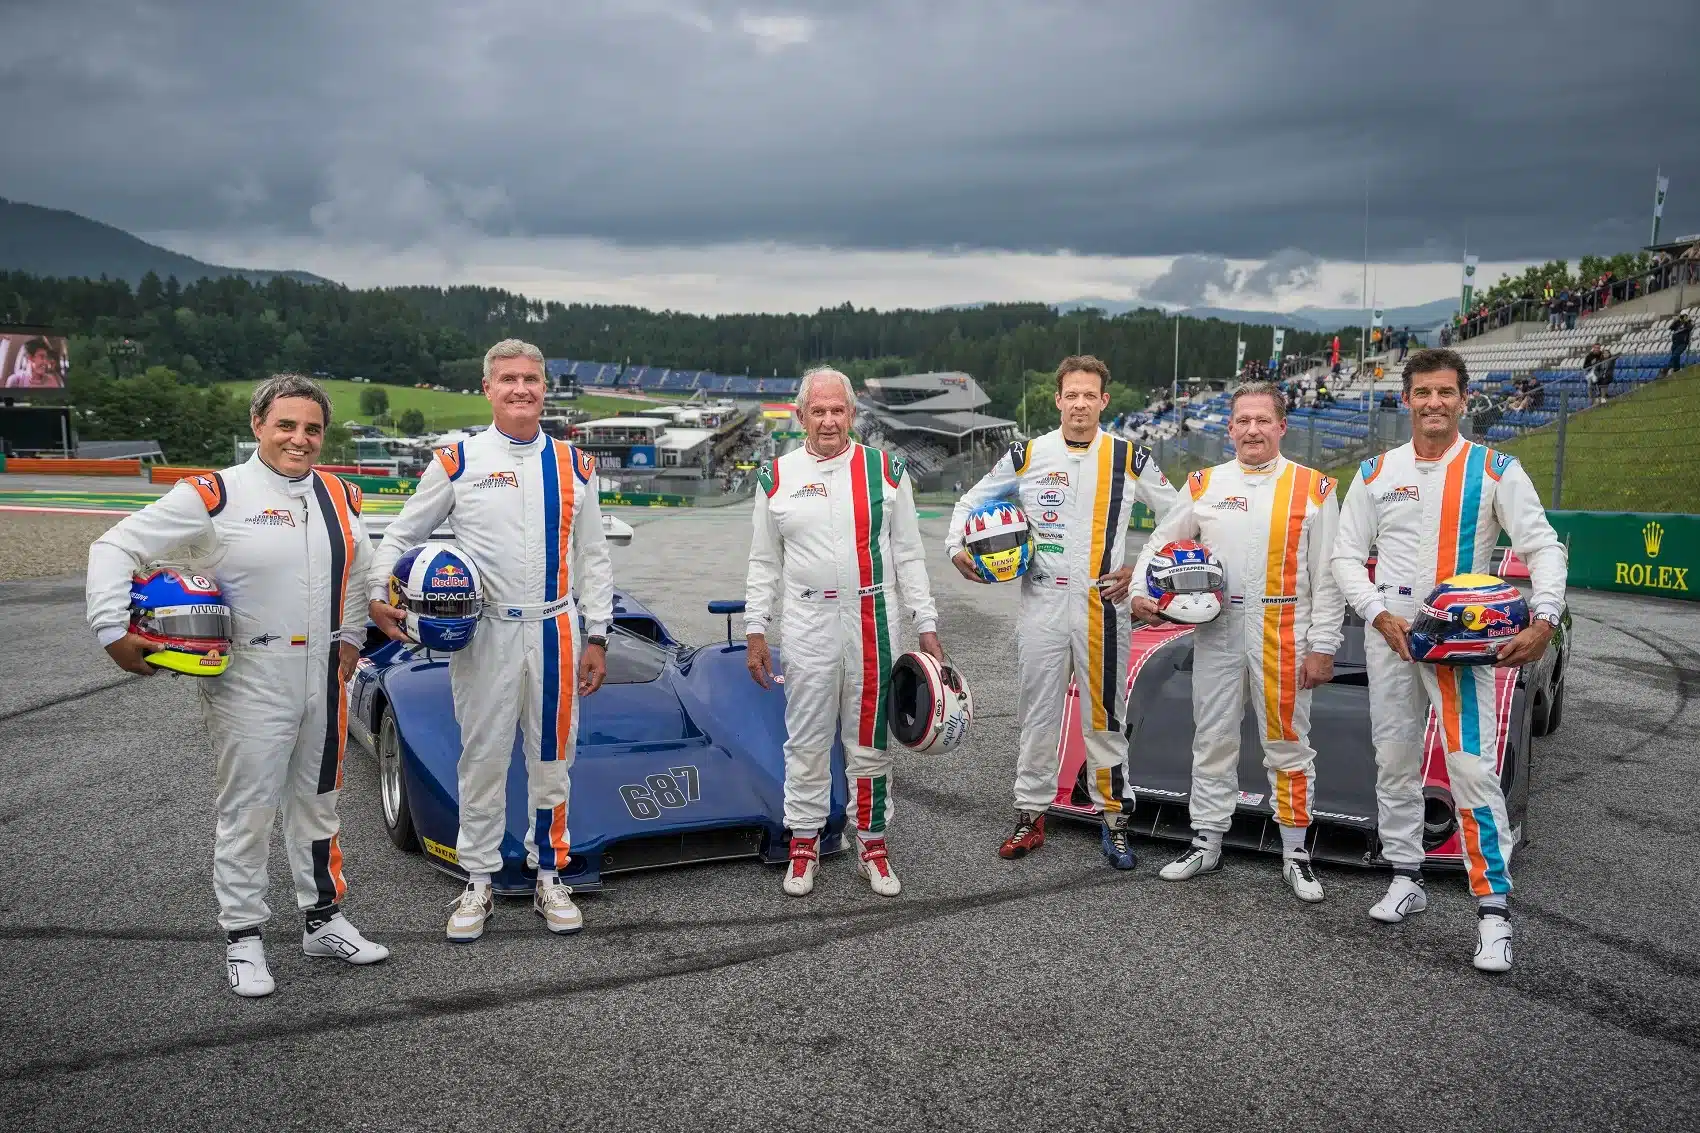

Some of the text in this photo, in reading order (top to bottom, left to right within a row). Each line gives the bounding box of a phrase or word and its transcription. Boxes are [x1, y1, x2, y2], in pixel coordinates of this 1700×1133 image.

[991, 557, 1015, 567] DENSO
[1168, 565, 1205, 574] VERSTAPPEN
[1614, 562, 1689, 591] ROLEX
[431, 577, 469, 588] Red Bull
[425, 591, 475, 601] ORACLE
[1261, 596, 1299, 604] VERSTAPPEN
[1487, 624, 1520, 637] Red Bull
[618, 764, 701, 821] 687
[1131, 785, 1188, 797] Castrol
